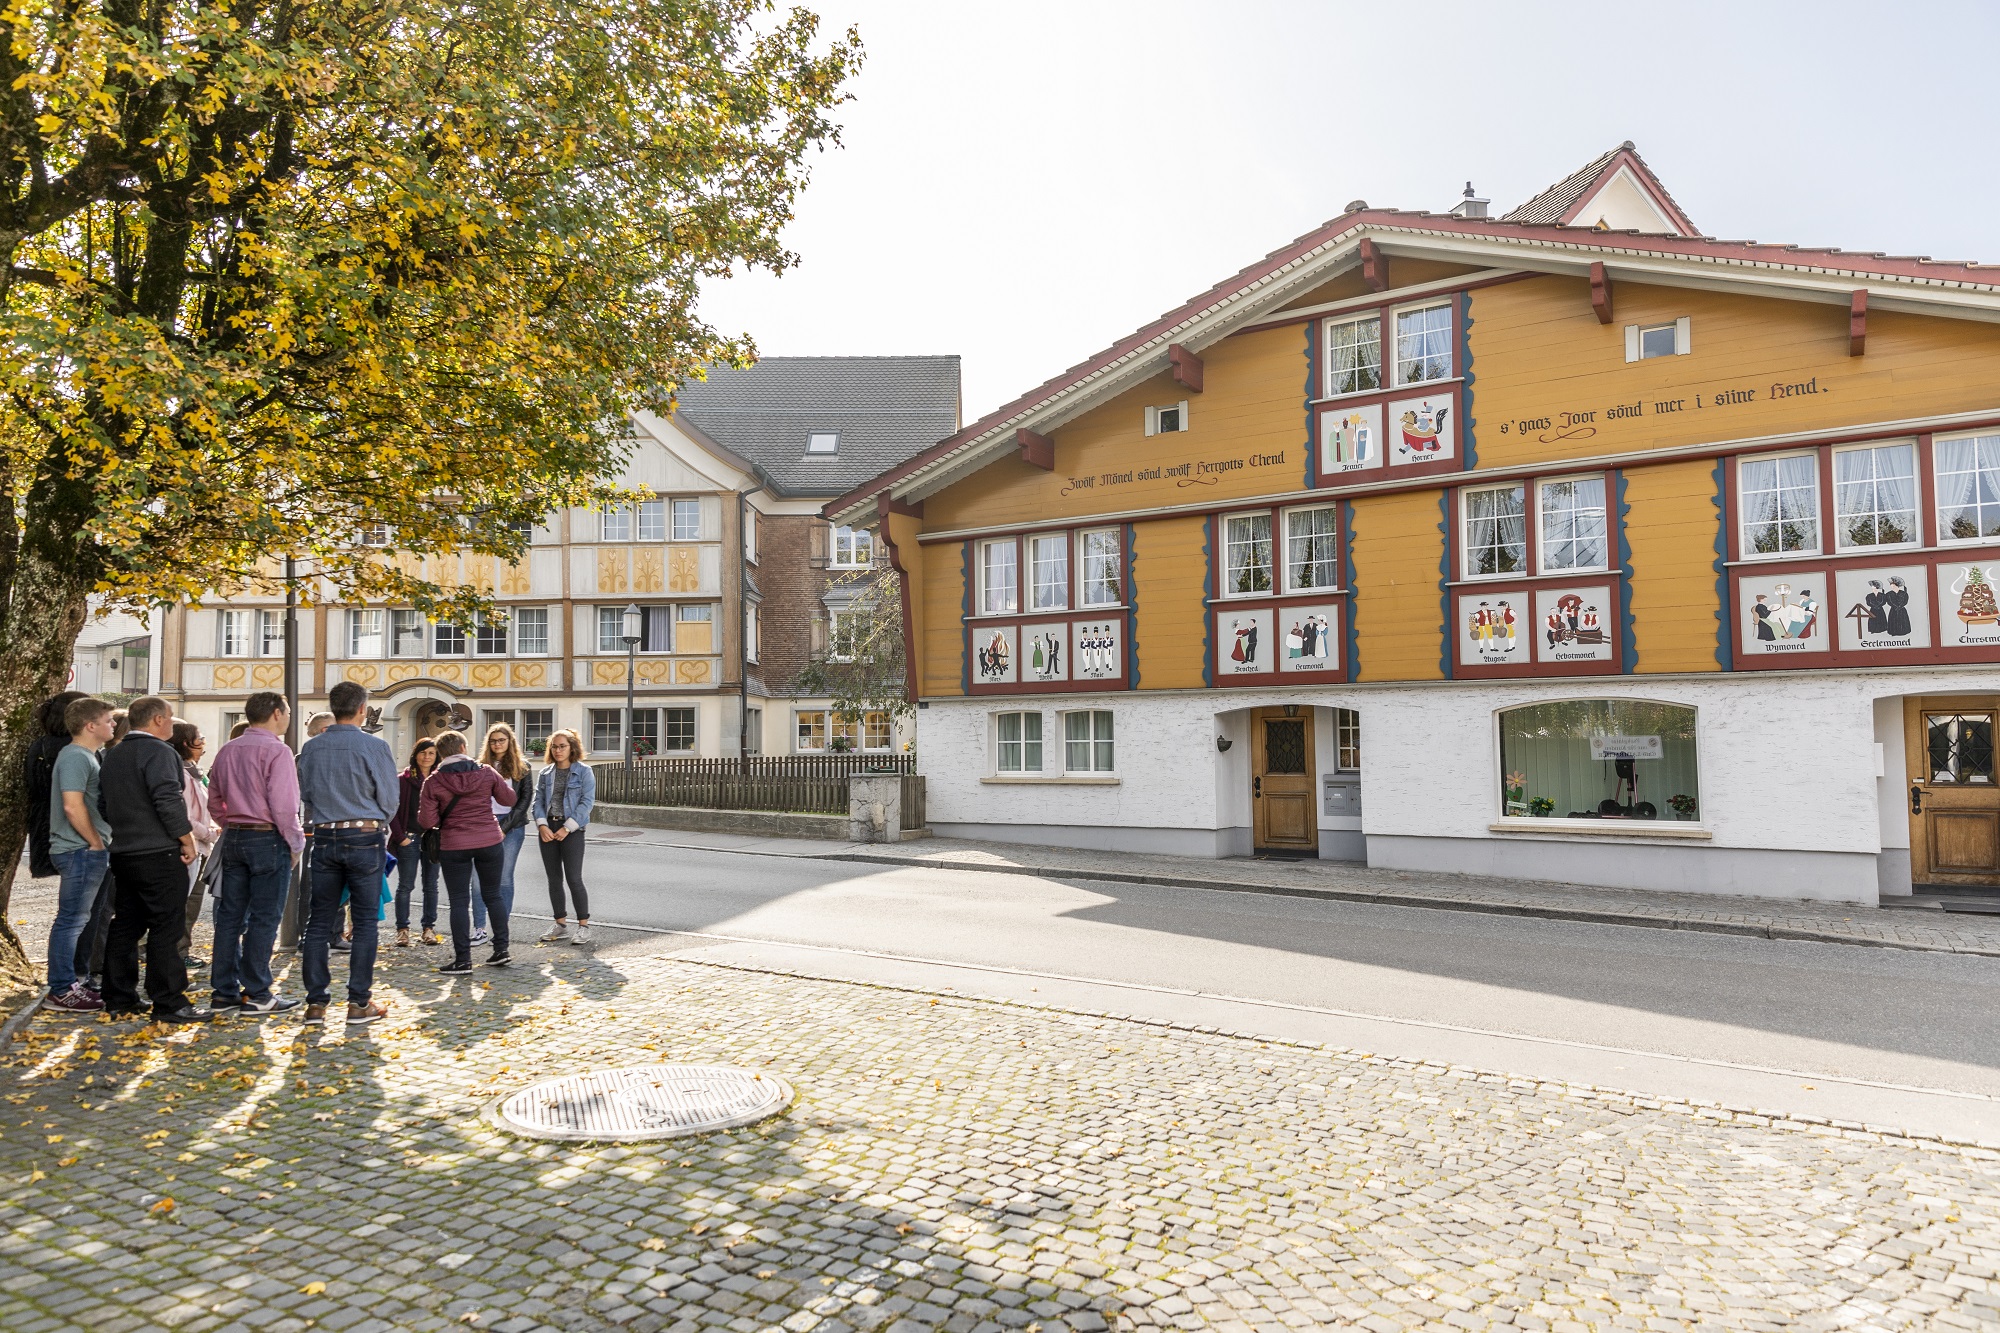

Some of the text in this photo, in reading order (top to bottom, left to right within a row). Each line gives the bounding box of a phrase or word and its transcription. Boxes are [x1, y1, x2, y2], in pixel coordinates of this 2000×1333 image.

[1607, 401, 1642, 419] sönd
[1715, 388, 1756, 406] siine
[1061, 474, 1096, 496] Zwölf
[1138, 466, 1162, 481] sönd
[1164, 462, 1192, 479] zwölf
[1249, 450, 1285, 468] Chend
